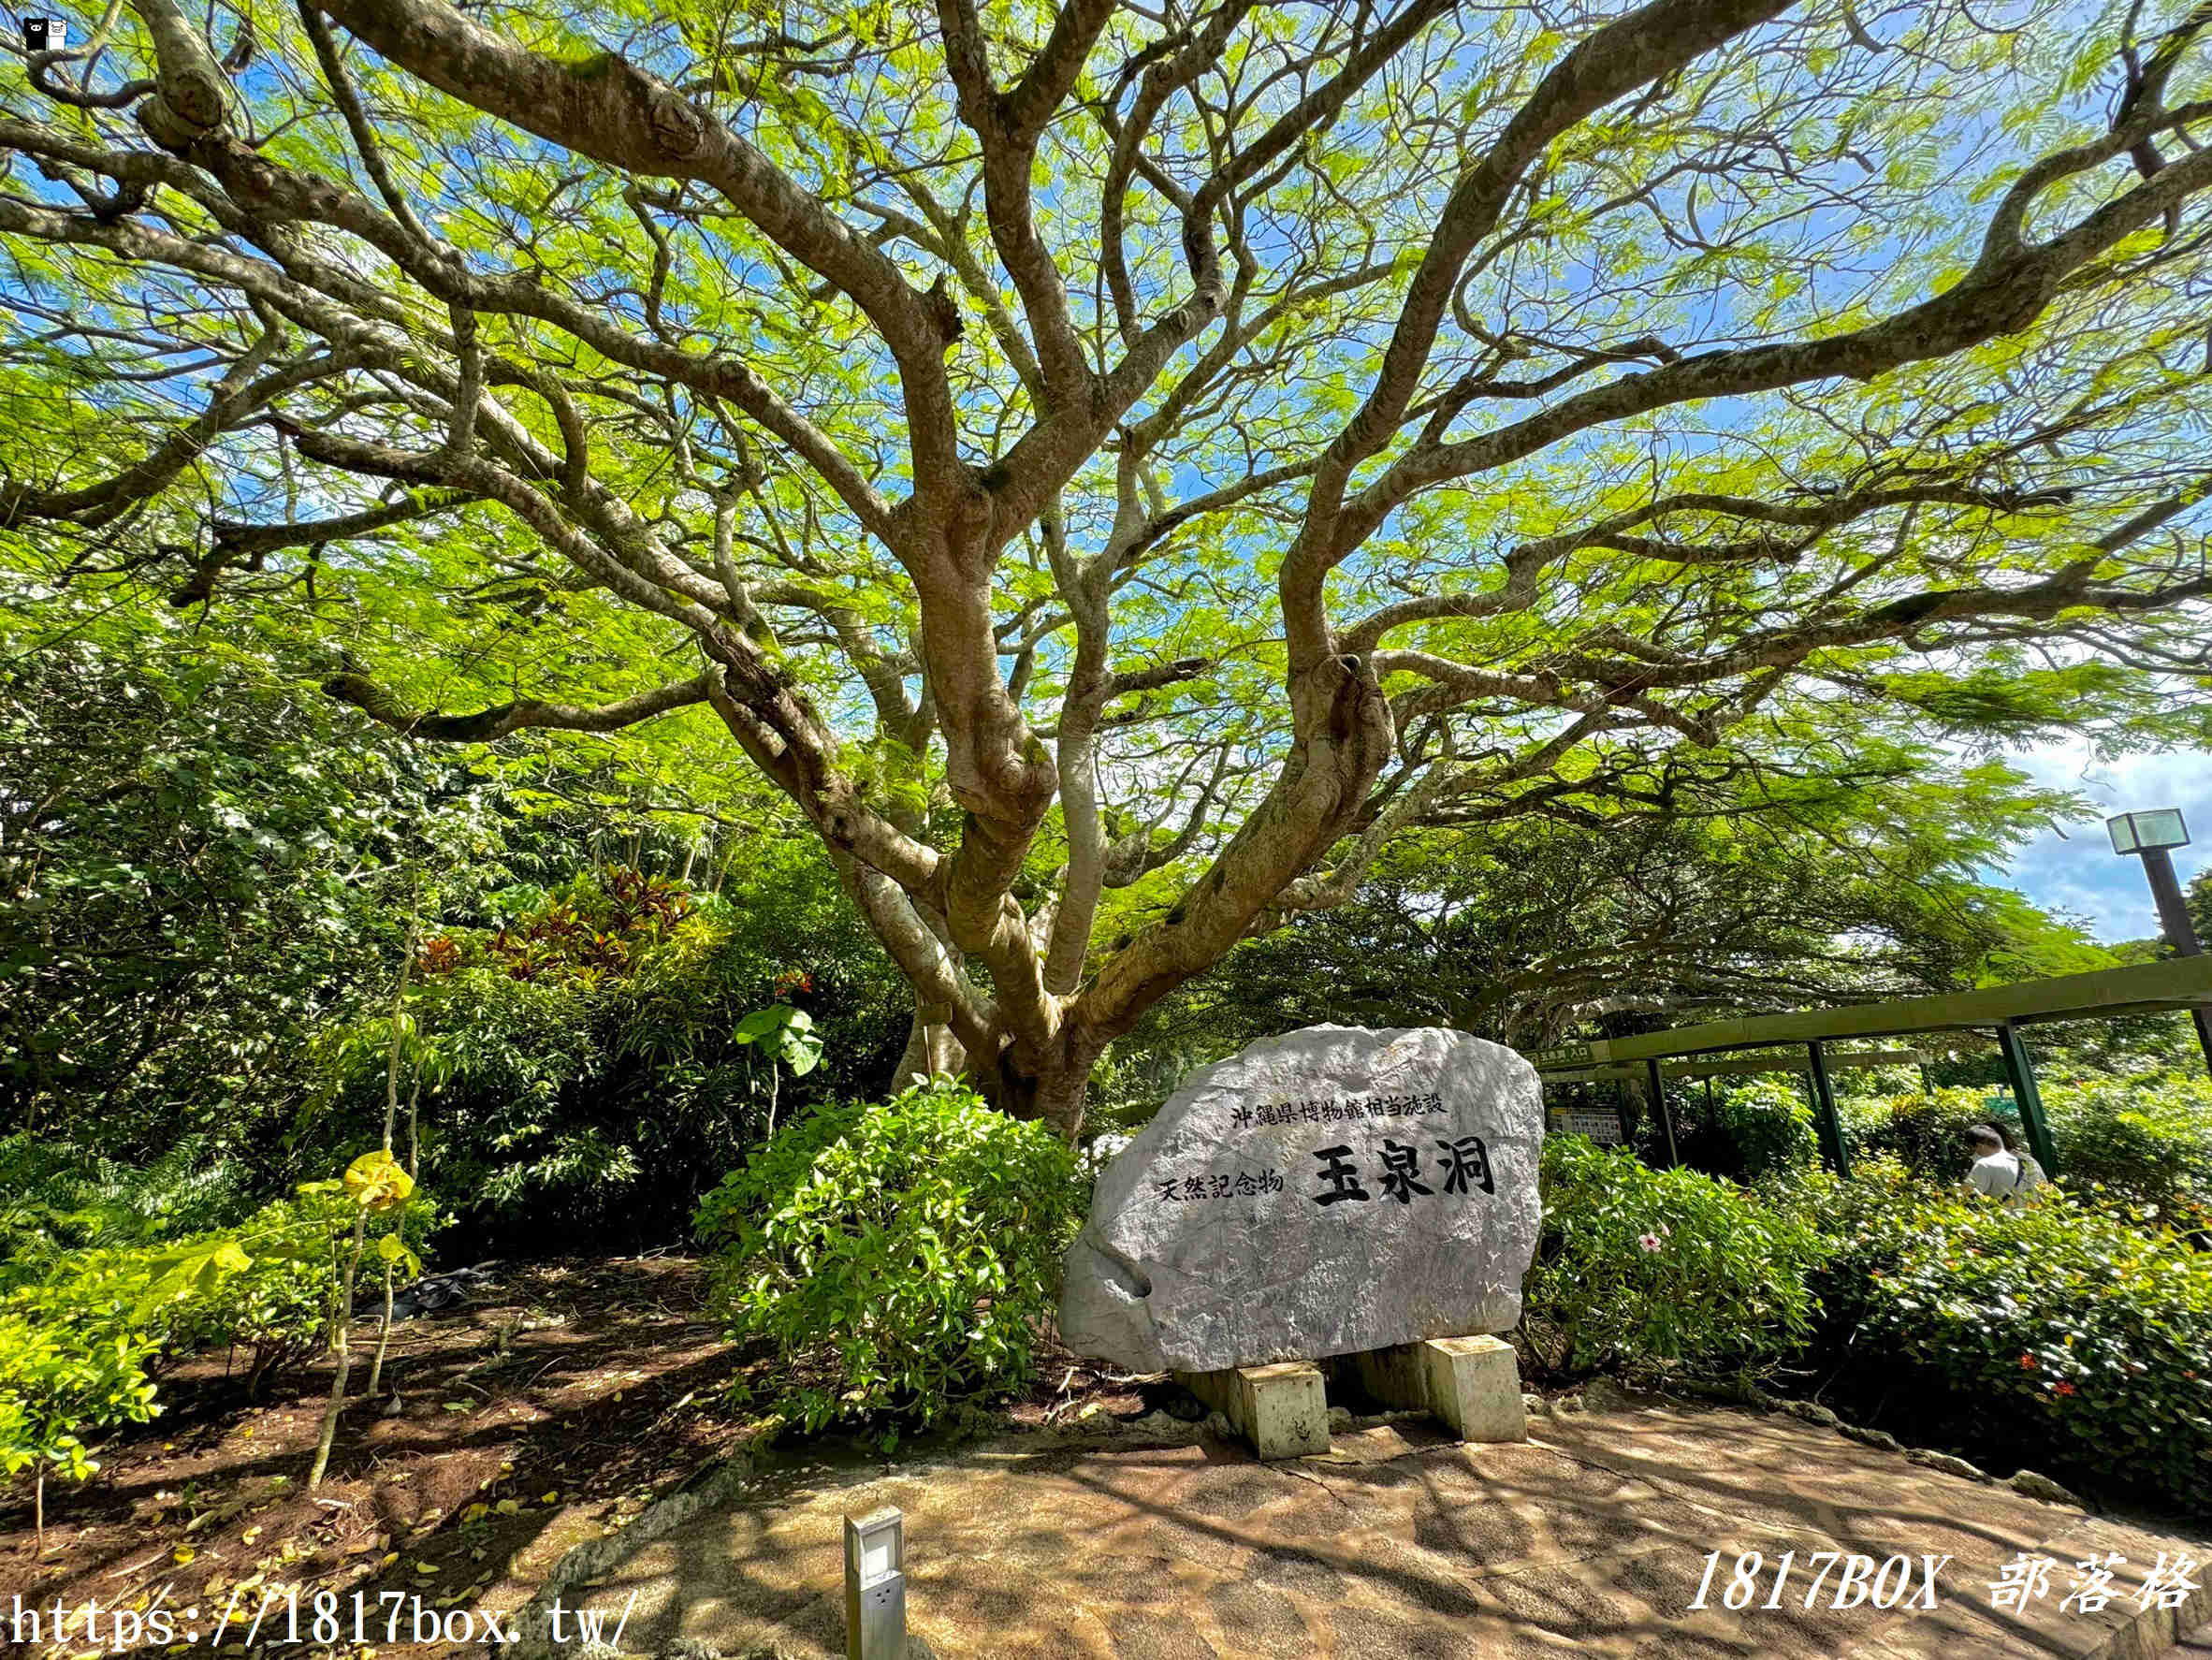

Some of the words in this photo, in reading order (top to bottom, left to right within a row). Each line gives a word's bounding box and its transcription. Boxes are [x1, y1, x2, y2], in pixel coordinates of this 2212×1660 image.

[1231, 1093, 1448, 1129] 沖縄県博物館相当施設
[1159, 1169, 1284, 1202] 天然記念物
[1312, 1136, 1495, 1207] 玉泉洞
